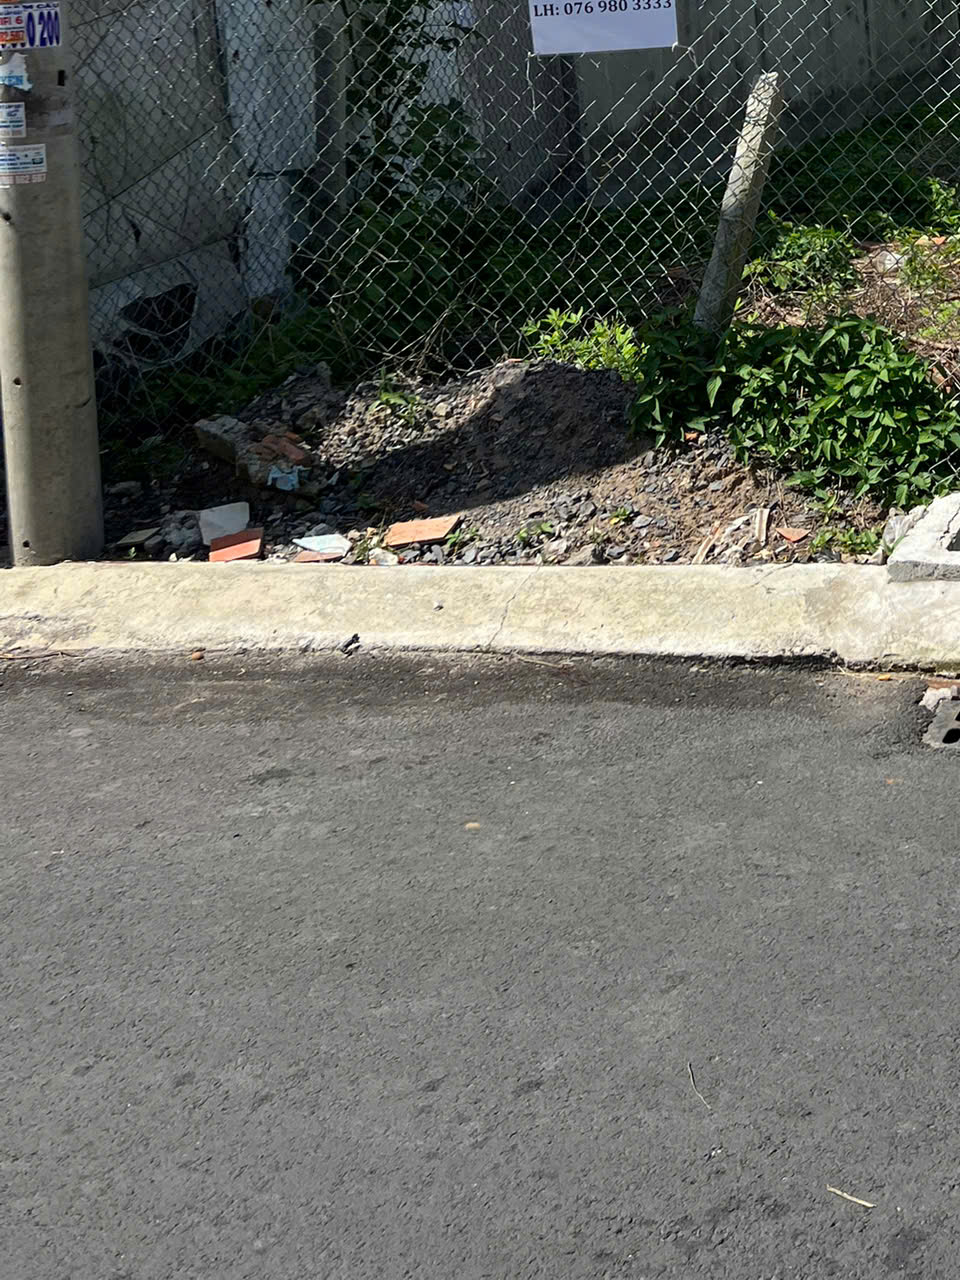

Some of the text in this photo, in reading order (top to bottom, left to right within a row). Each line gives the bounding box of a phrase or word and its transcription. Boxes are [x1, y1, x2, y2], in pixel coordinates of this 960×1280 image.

[534, 3, 560, 17] LH:
[564, 1, 594, 16] 076
[598, 0, 628, 13] 980
